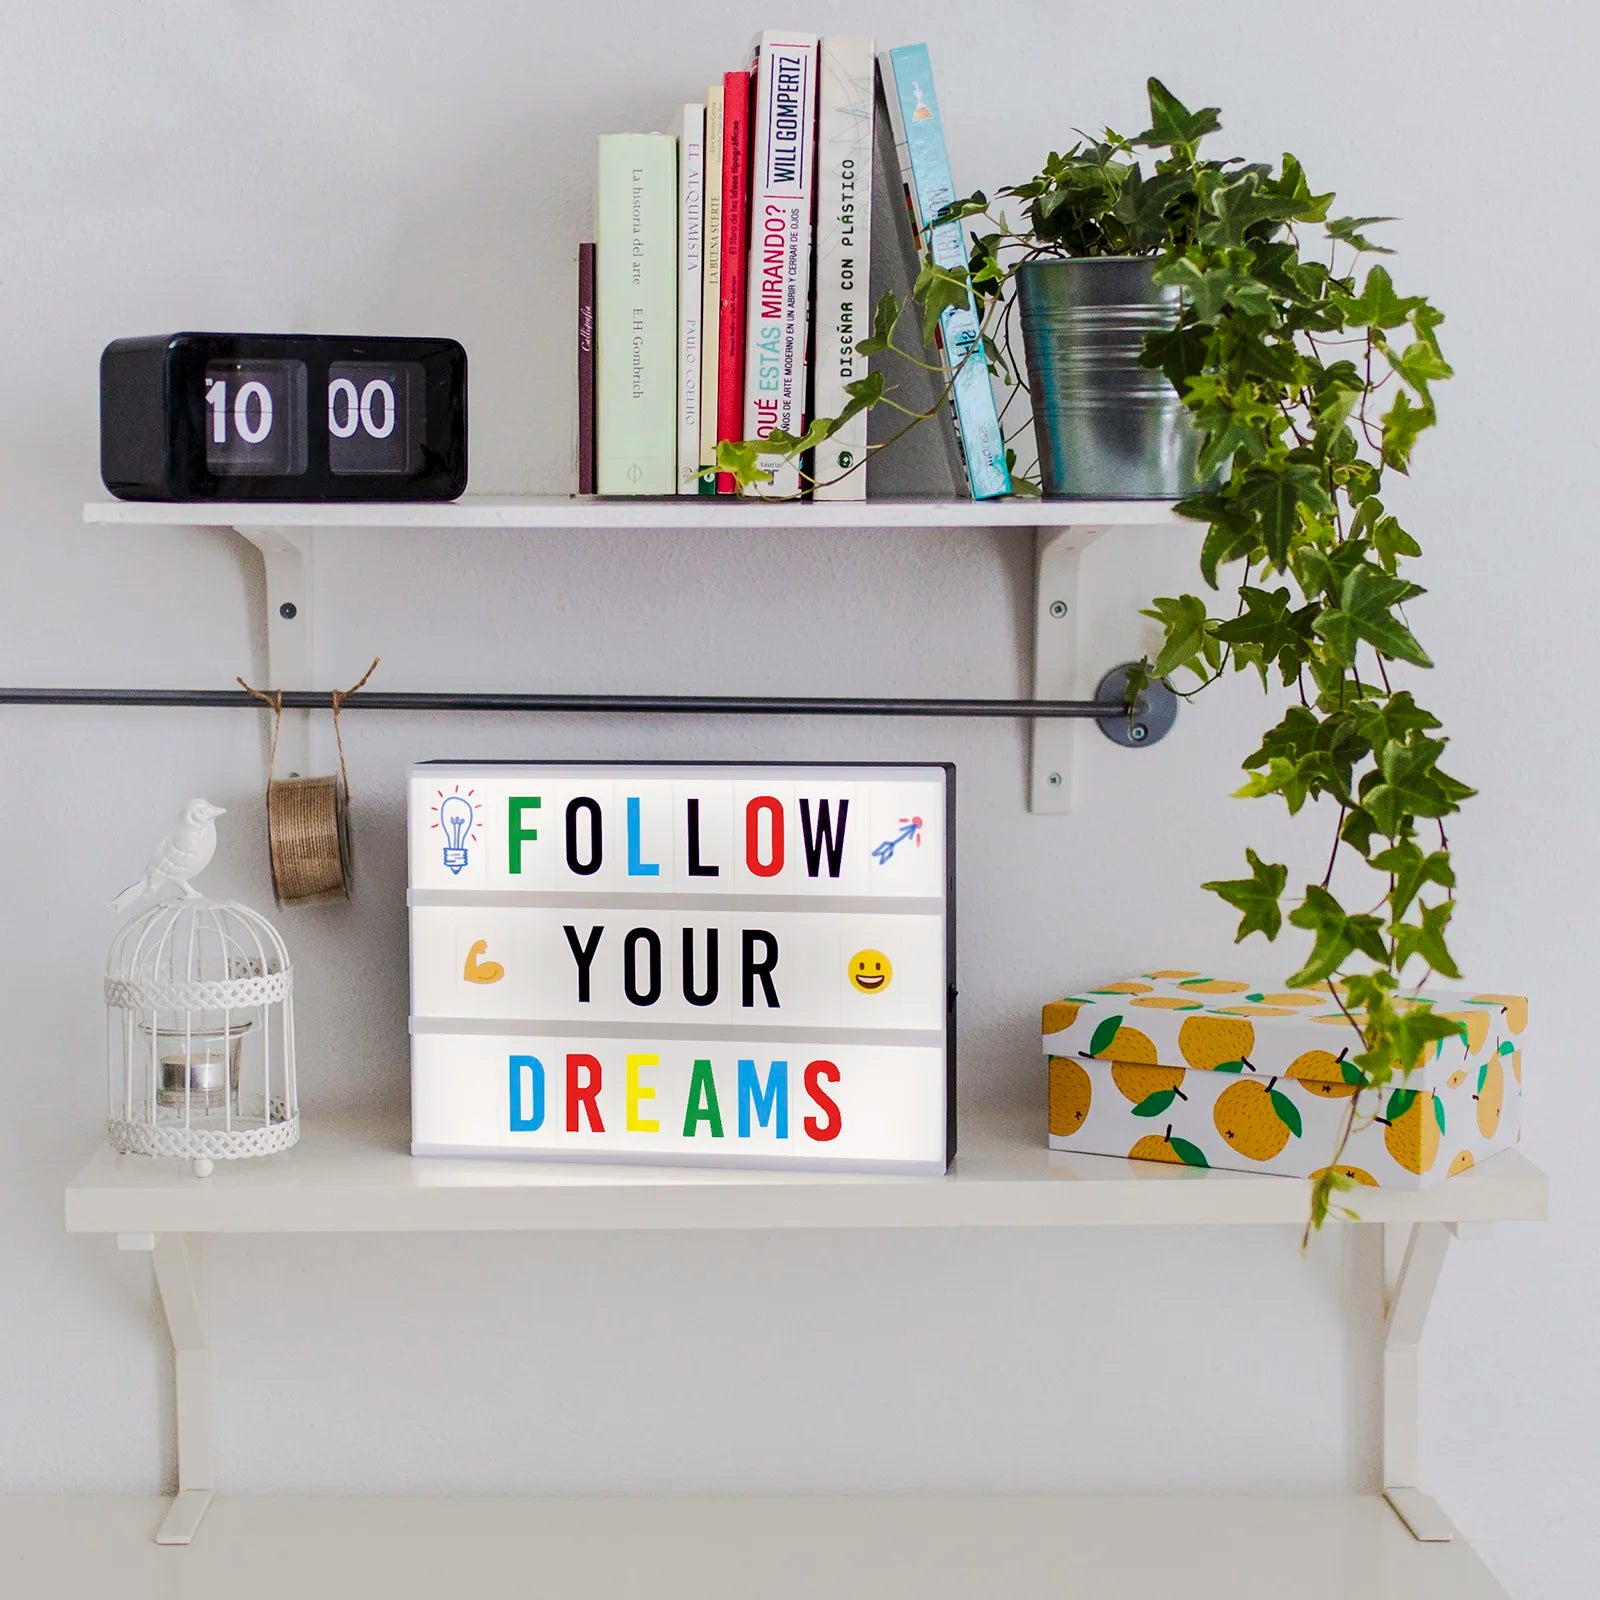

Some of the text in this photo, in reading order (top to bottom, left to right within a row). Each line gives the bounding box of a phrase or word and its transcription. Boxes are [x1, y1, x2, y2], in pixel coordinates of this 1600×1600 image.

[773, 57, 800, 182] WILL GOMPERTZ
[632, 168, 644, 286] La historia del arte
[686, 144, 699, 271] EL ALQUIMISTA
[709, 196, 720, 284] LA BUENA SUERTE
[790, 232, 799, 242] DE
[791, 208, 800, 229] OJOS
[761, 204, 787, 319] MIRANDO?
[788, 244, 798, 275] CERRAR
[836, 158, 855, 378] DISEÑAR CON PLÁSTICO
[786, 323, 795, 335] EN
[787, 286, 796, 309] ABRIR
[787, 310, 795, 321] UN
[685, 319, 696, 426] PAULO COELHO
[757, 326, 781, 391] ESTÁS
[783, 378, 792, 398] ARTE
[784, 335, 794, 376] MODERNO
[205, 378, 395, 443] 10 00
[783, 400, 792, 411] DE
[508, 795, 849, 878] FOLLOW
[563, 925, 780, 1009] YOUR
[508, 1054, 842, 1142] DREAMS
